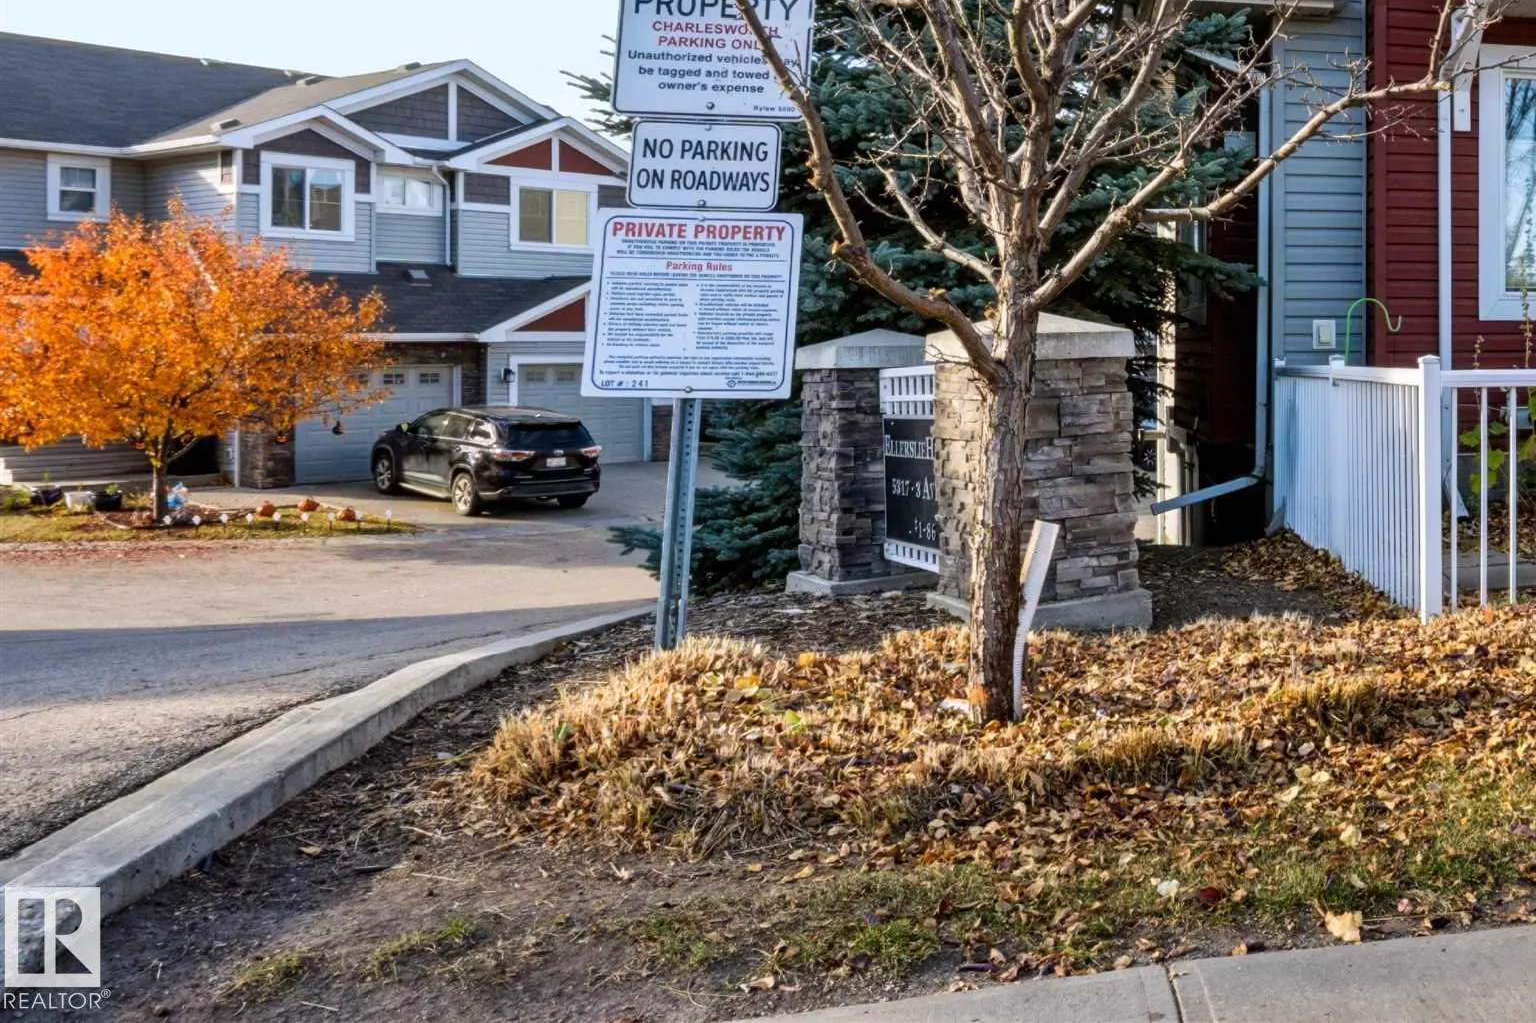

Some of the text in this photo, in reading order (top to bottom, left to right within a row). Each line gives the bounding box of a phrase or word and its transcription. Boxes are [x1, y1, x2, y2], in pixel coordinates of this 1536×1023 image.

[652, 20, 779, 37] CHARLESWOH
[658, 36, 763, 50] PARKING ONL
[628, 50, 713, 63] Unauthorized
[716, 53, 768, 65] vehicles
[638, 65, 654, 76] be
[658, 66, 701, 80] tagged
[705, 67, 728, 79] and
[732, 69, 770, 80] towed
[658, 80, 765, 94] owner's expense
[642, 138, 769, 162] NO PARKING
[636, 168, 770, 192] ON ROADWAYS
[612, 221, 786, 241] PRIVATE PROPERTY
[666, 261, 733, 272] Parking Rules
